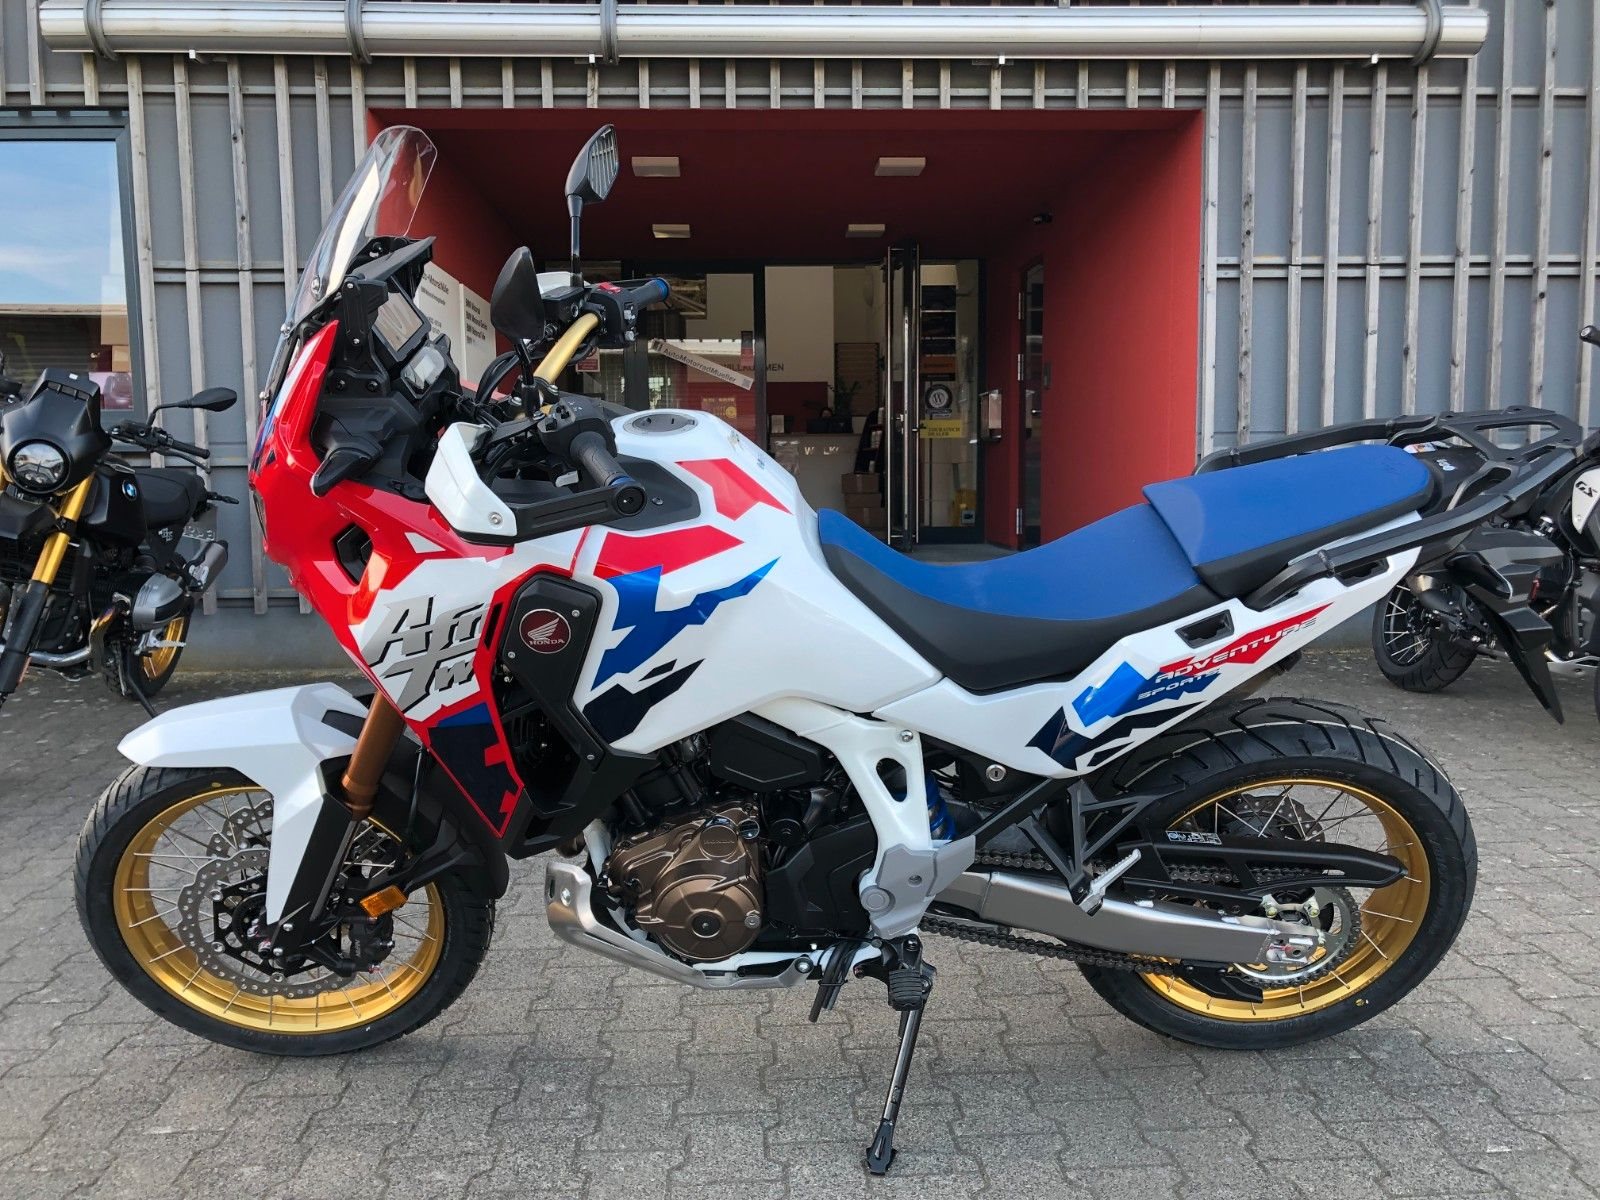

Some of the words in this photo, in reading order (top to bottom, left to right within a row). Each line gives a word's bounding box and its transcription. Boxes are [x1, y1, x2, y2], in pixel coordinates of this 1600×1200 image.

[663, 348, 736, 383] AutoMotorradMueller
[1575, 480, 1598, 498] GS
[1154, 617, 1317, 684] ADVENTURE
[1137, 668, 1221, 701] SPORTS
